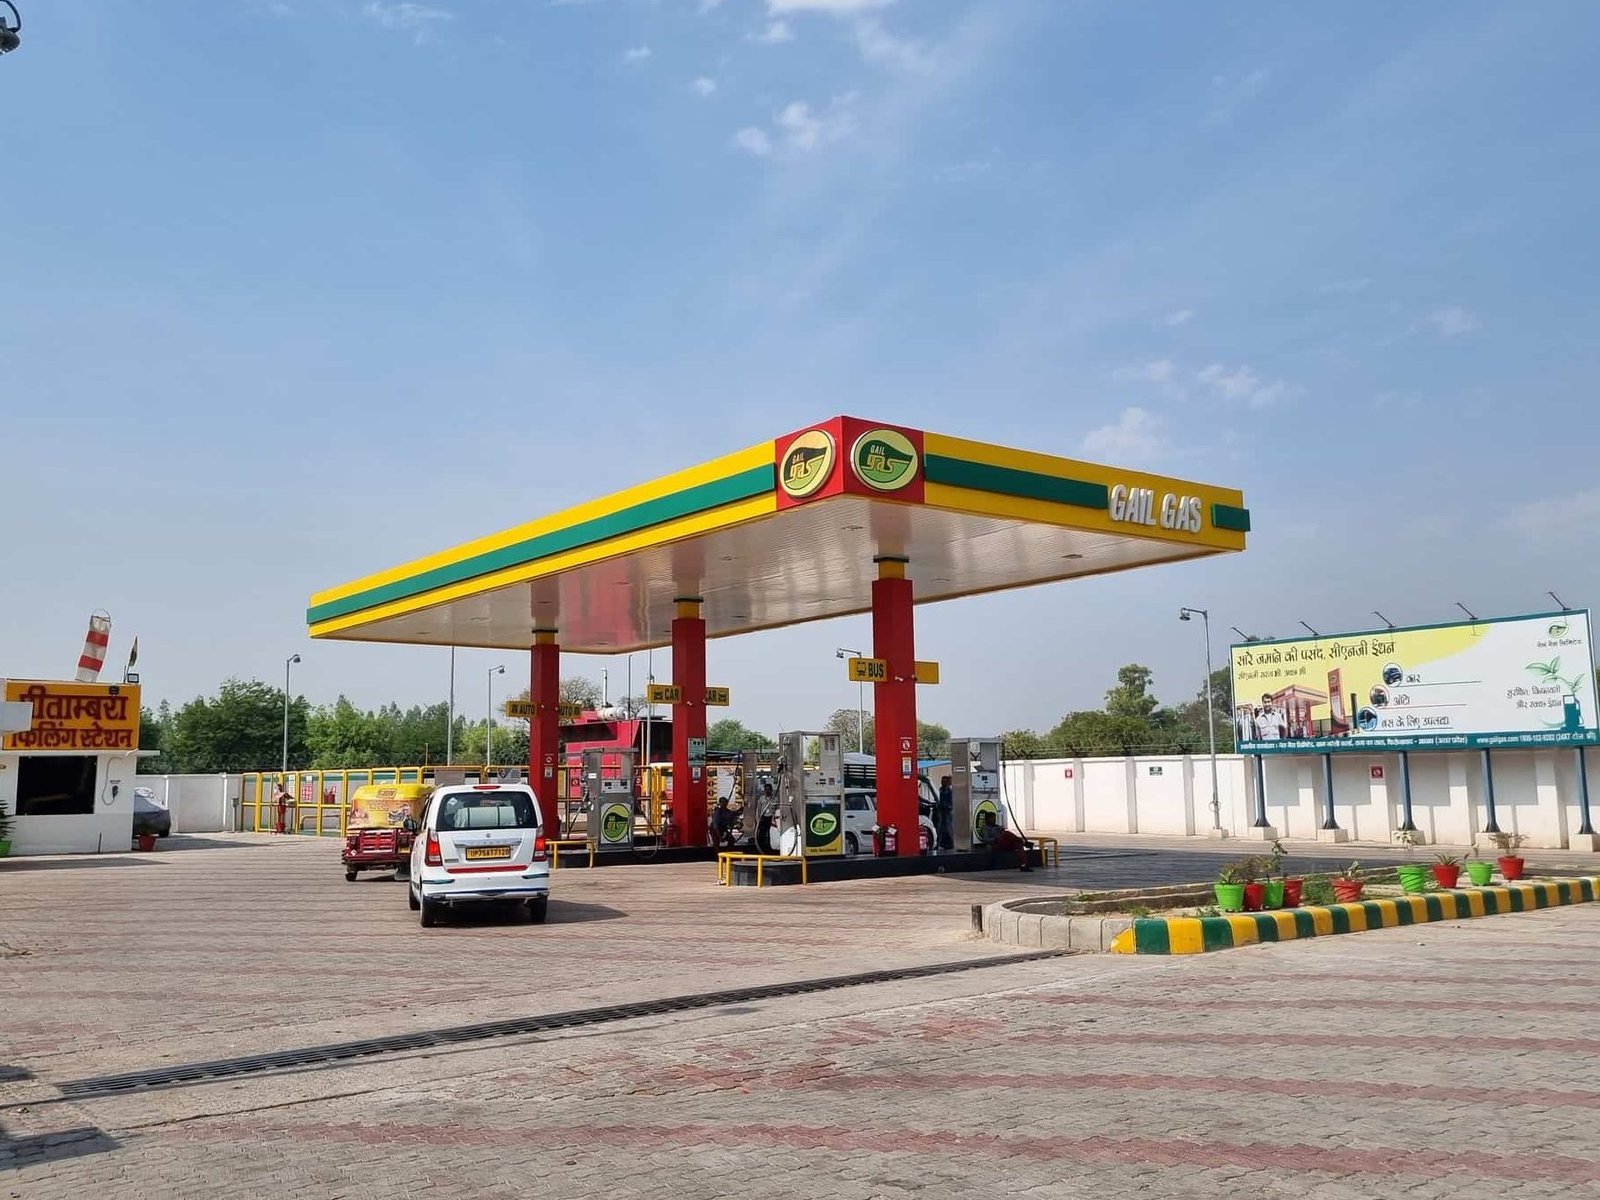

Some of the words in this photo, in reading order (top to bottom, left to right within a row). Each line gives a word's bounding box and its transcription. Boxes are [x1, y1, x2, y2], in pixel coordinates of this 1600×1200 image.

[870, 444, 885, 455] GAIL
[792, 452, 804, 463] GAIL
[1110, 484, 1156, 526] GAIL
[1160, 493, 1202, 533] GAS
[1237, 649, 1254, 666] सारे
[1256, 649, 1282, 666] जमाने
[1285, 646, 1298, 662] की
[1329, 640, 1369, 661] सीएनजी
[868, 662, 884, 678] BUS
[664, 688, 679, 701] CAR
[706, 690, 717, 702] AR
[518, 704, 536, 715] AUTO
[559, 706, 573, 716] UTO
[80, 721, 133, 747] स्टेशन
